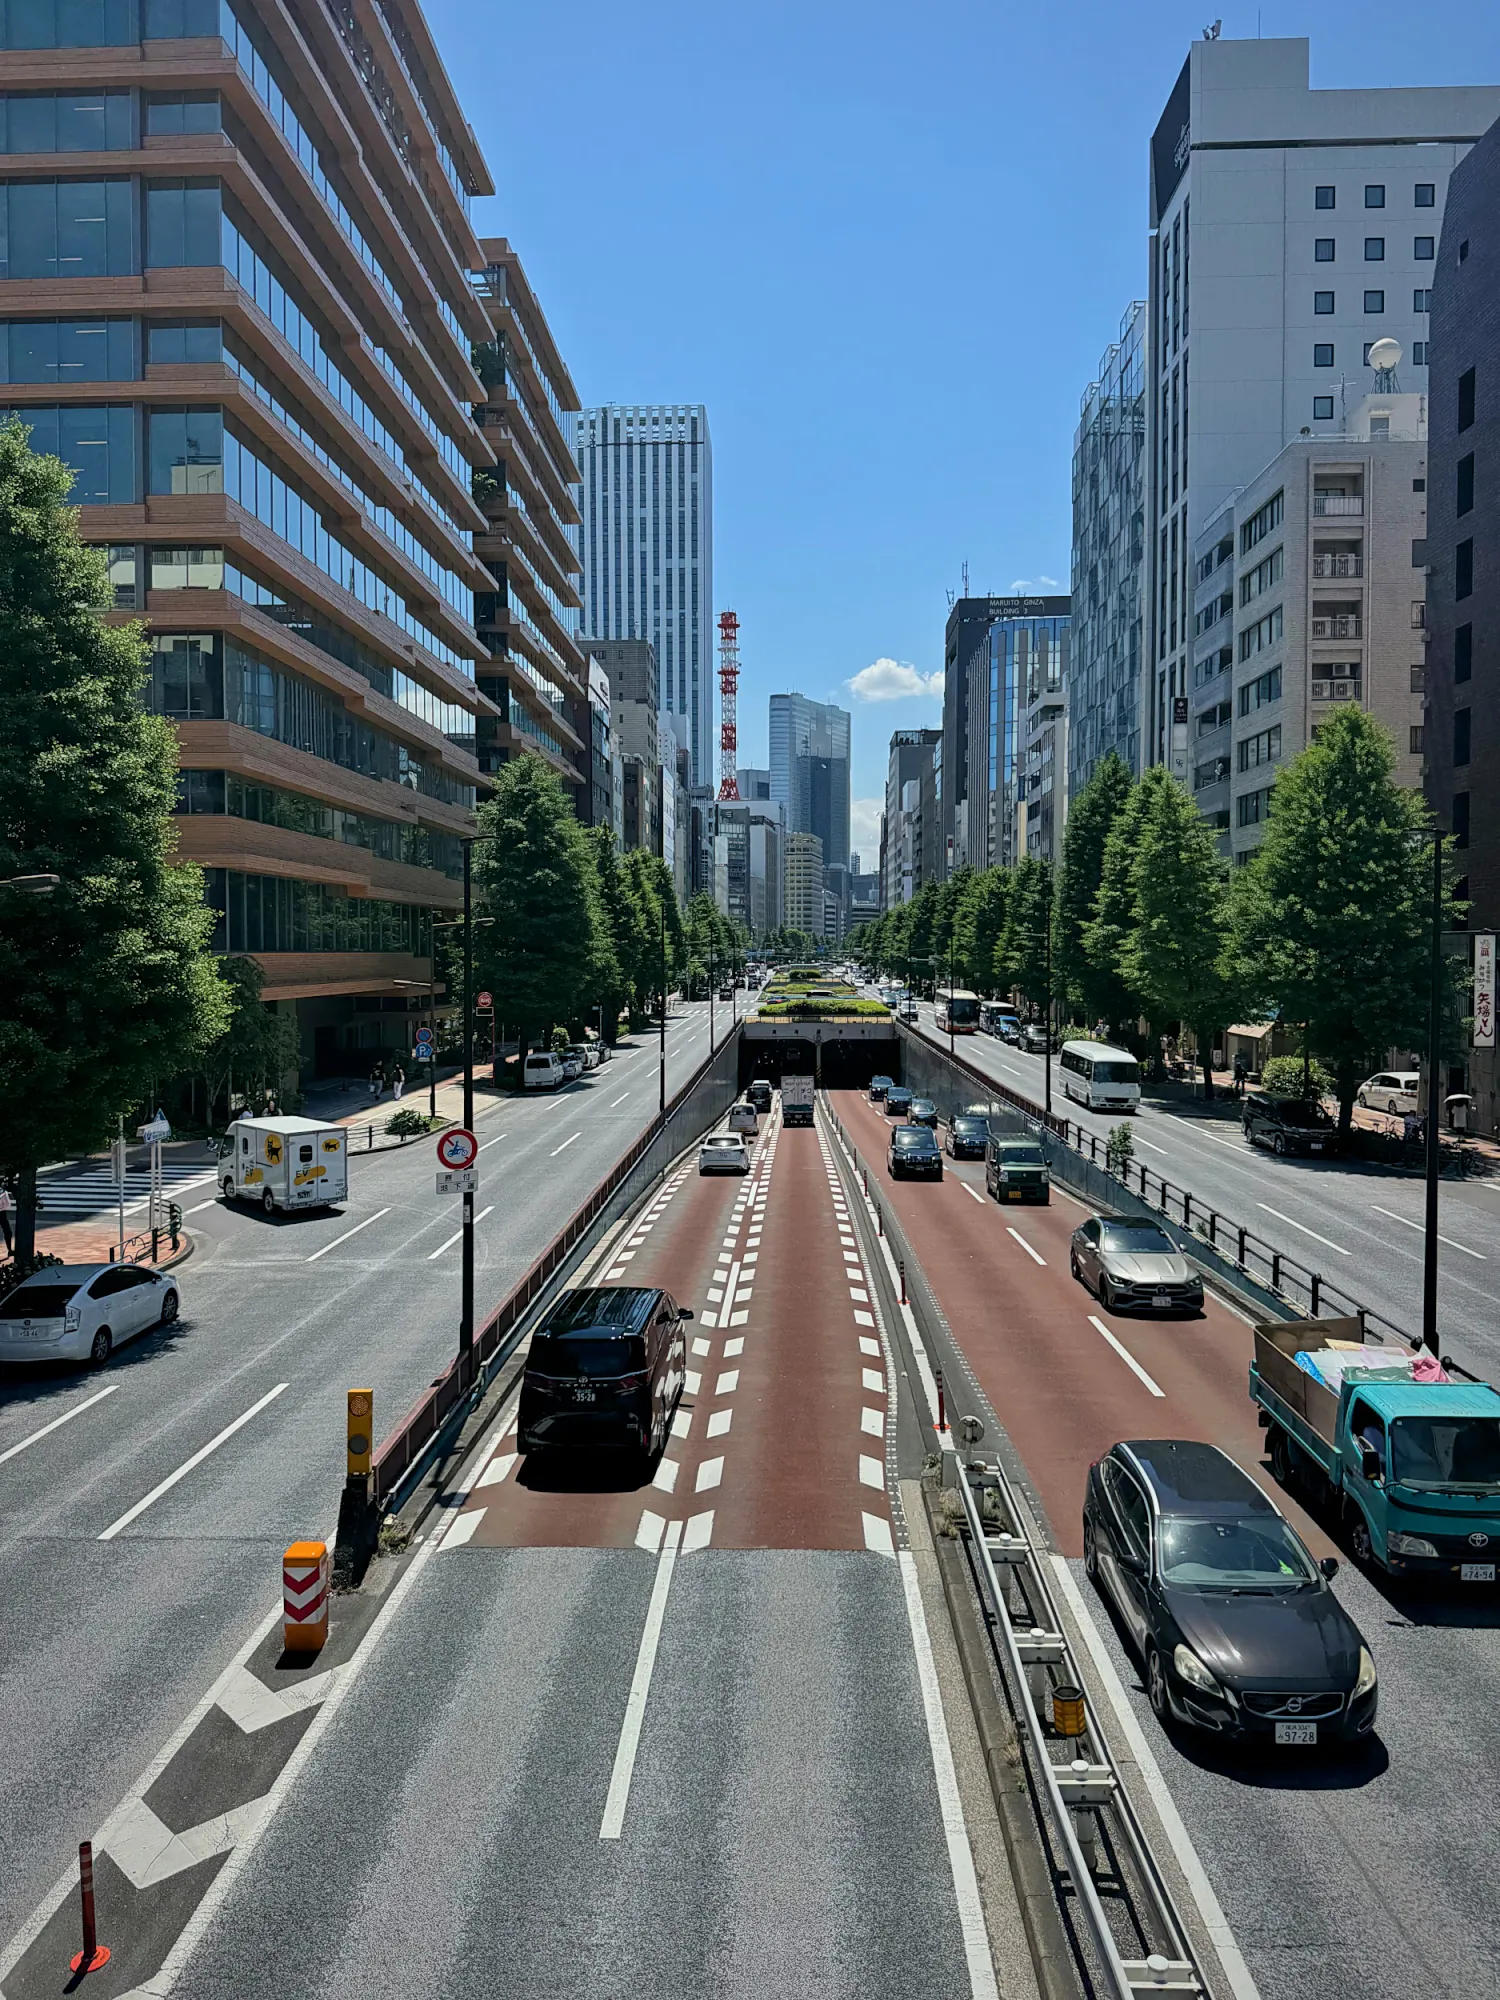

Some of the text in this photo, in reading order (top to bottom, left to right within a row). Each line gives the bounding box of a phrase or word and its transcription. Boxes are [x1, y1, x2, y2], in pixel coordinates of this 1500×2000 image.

[1475, 992, 1493, 1038] 矢場とん
[245, 1167, 254, 1177] EV
[296, 1170, 309, 1178] EV
[1284, 1731, 1315, 1742] 97-28
